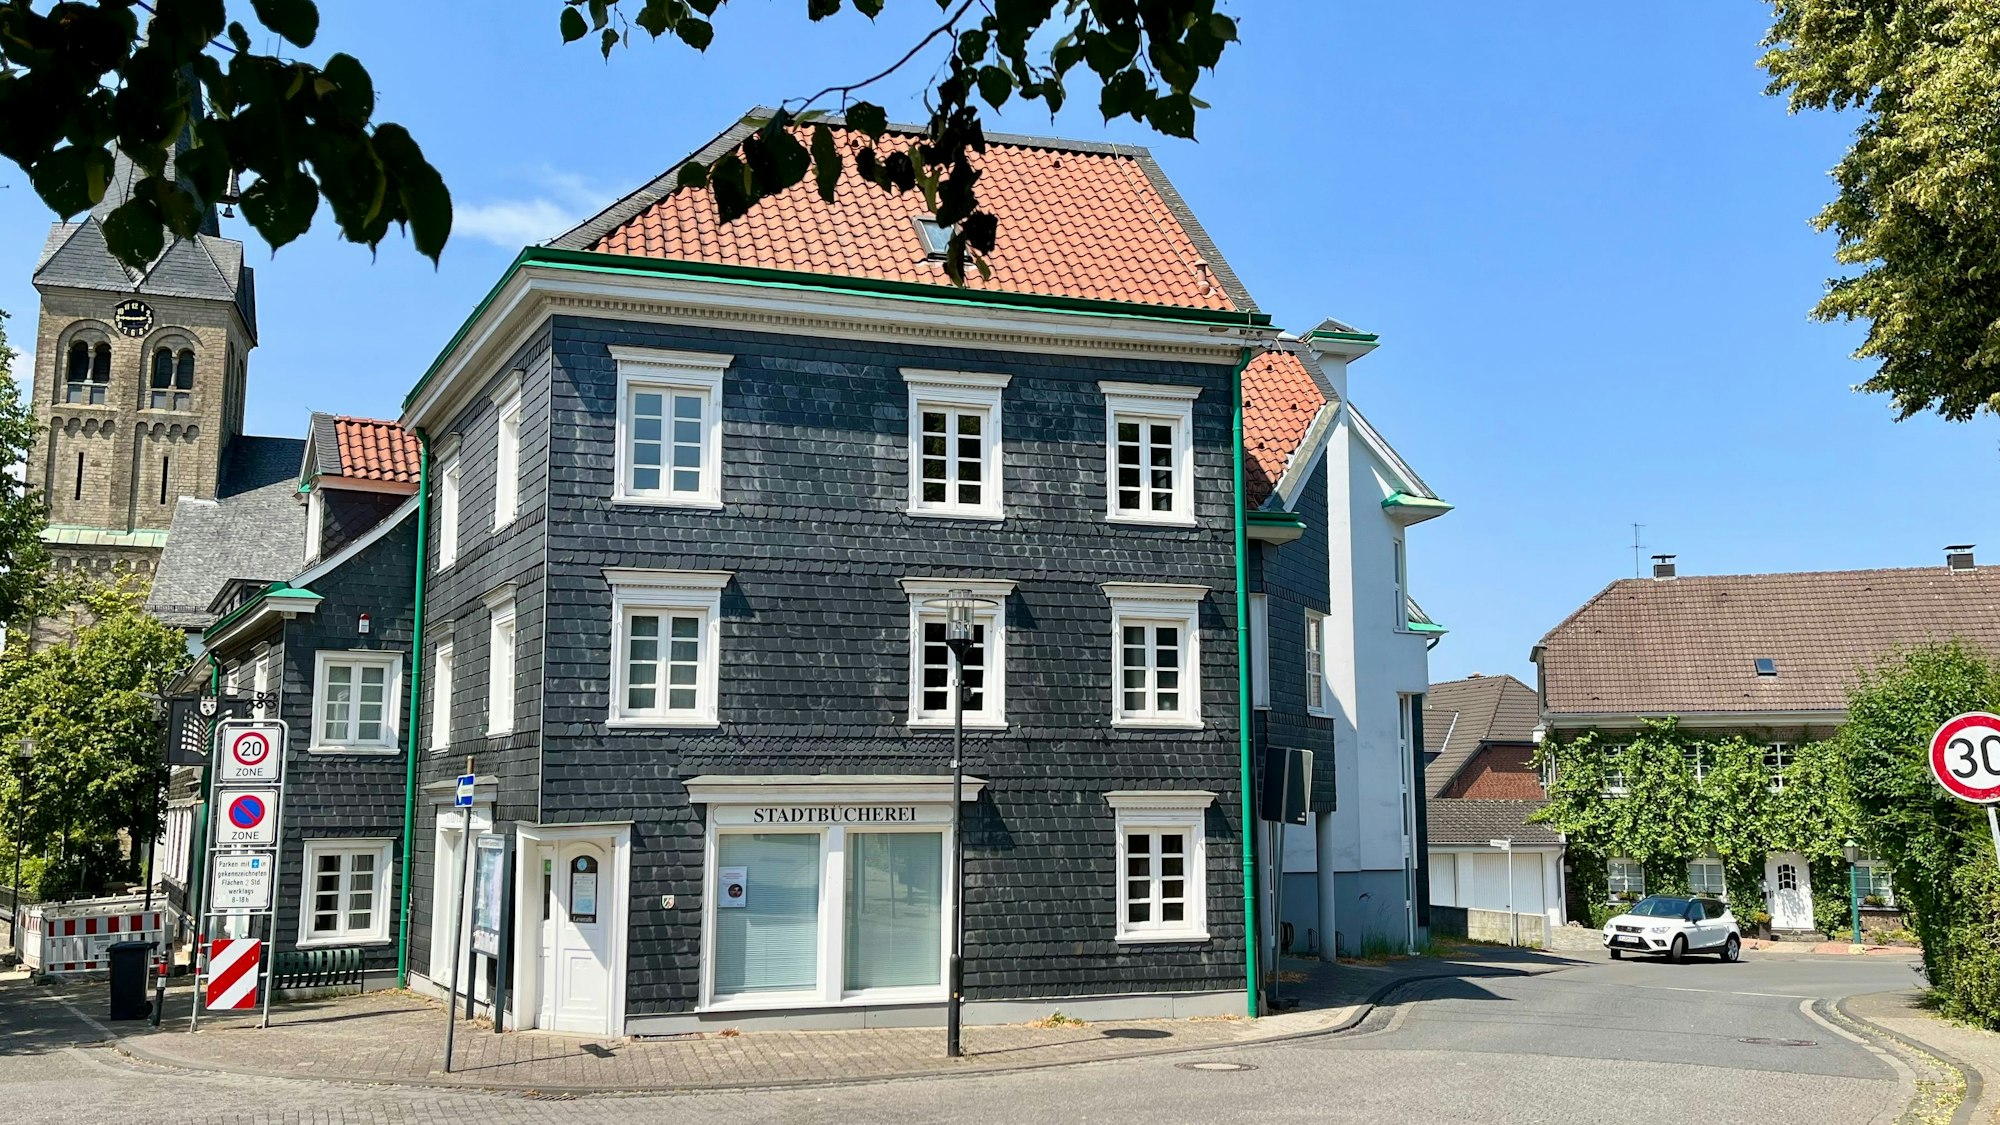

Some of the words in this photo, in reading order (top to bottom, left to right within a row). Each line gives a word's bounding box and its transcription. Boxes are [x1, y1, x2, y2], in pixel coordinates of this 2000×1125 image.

[241, 741, 262, 757] 20
[1948, 735, 2000, 778] 30
[235, 768, 264, 777] ZONE
[753, 805, 917, 823] STADTBÜCHEREI
[231, 831, 260, 840] ZONE
[217, 871, 267, 879] gekennzeichneten
